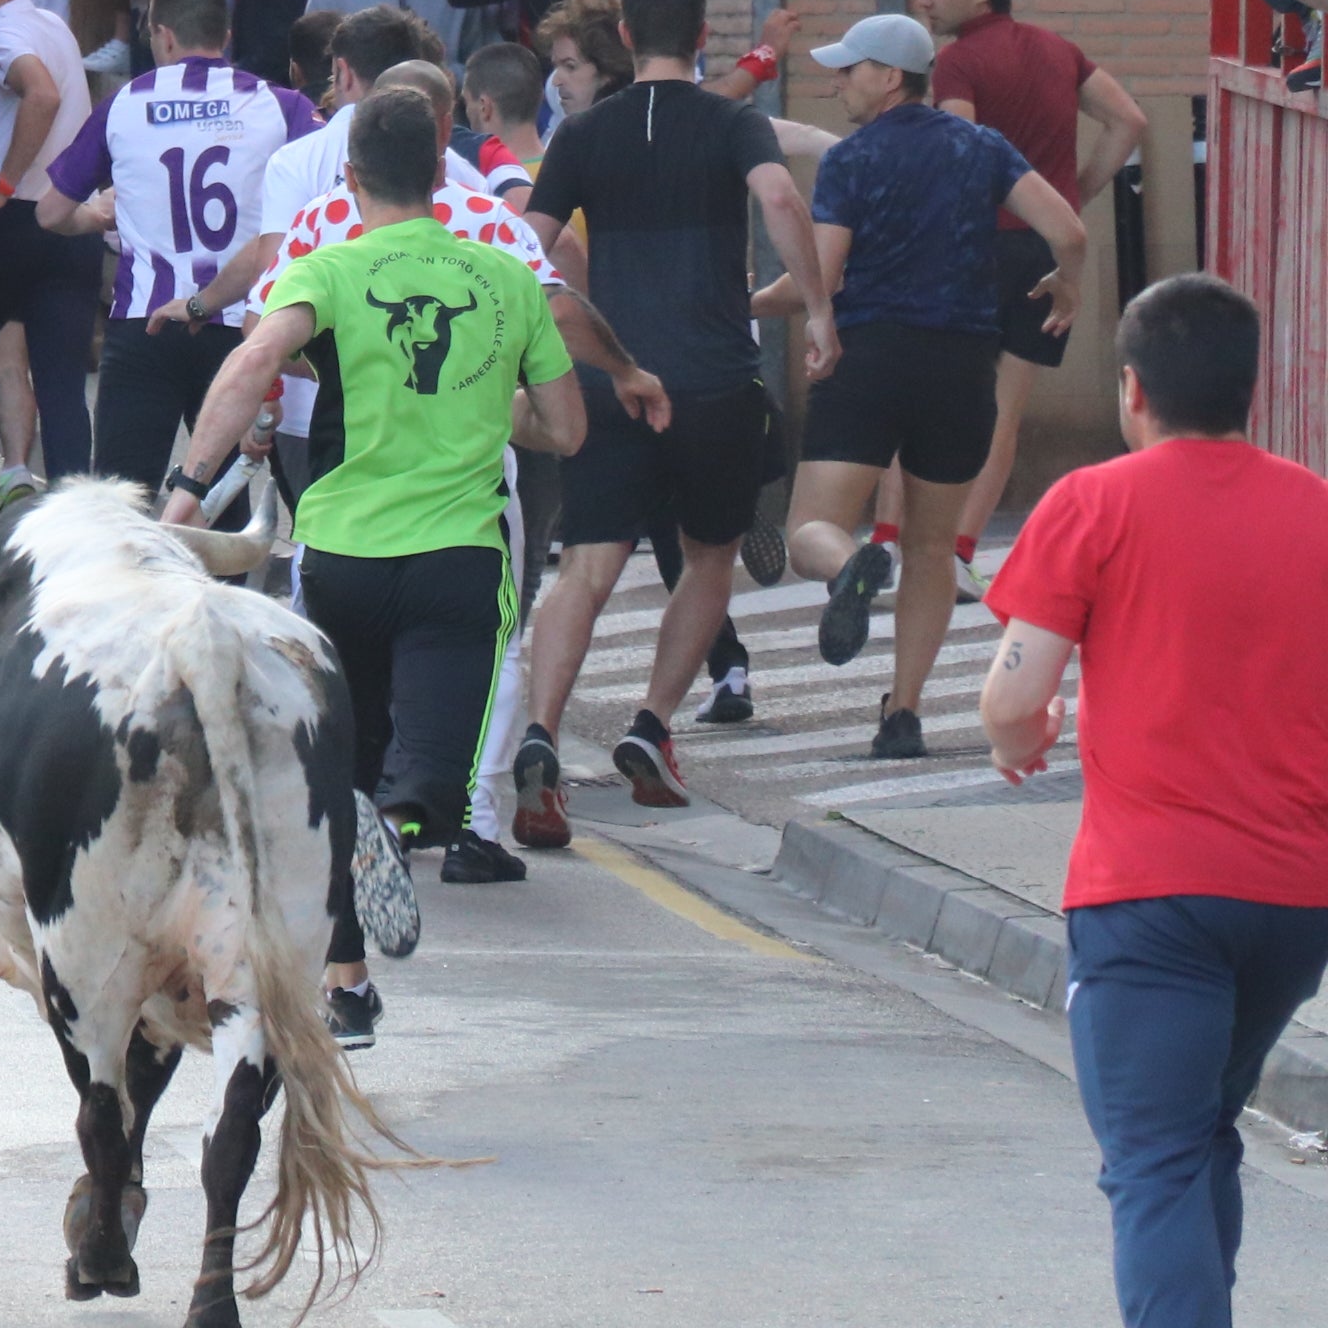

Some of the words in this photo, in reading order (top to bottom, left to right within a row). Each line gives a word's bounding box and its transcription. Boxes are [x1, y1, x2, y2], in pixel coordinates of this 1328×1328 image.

[155, 102, 230, 122] OMEGA
[159, 145, 238, 253] 16
[441, 256, 474, 274] TORO
[475, 274, 491, 290] EN
[489, 291, 500, 306] LA
[494, 310, 505, 348] CALLE
[458, 354, 498, 391] ARNEDO
